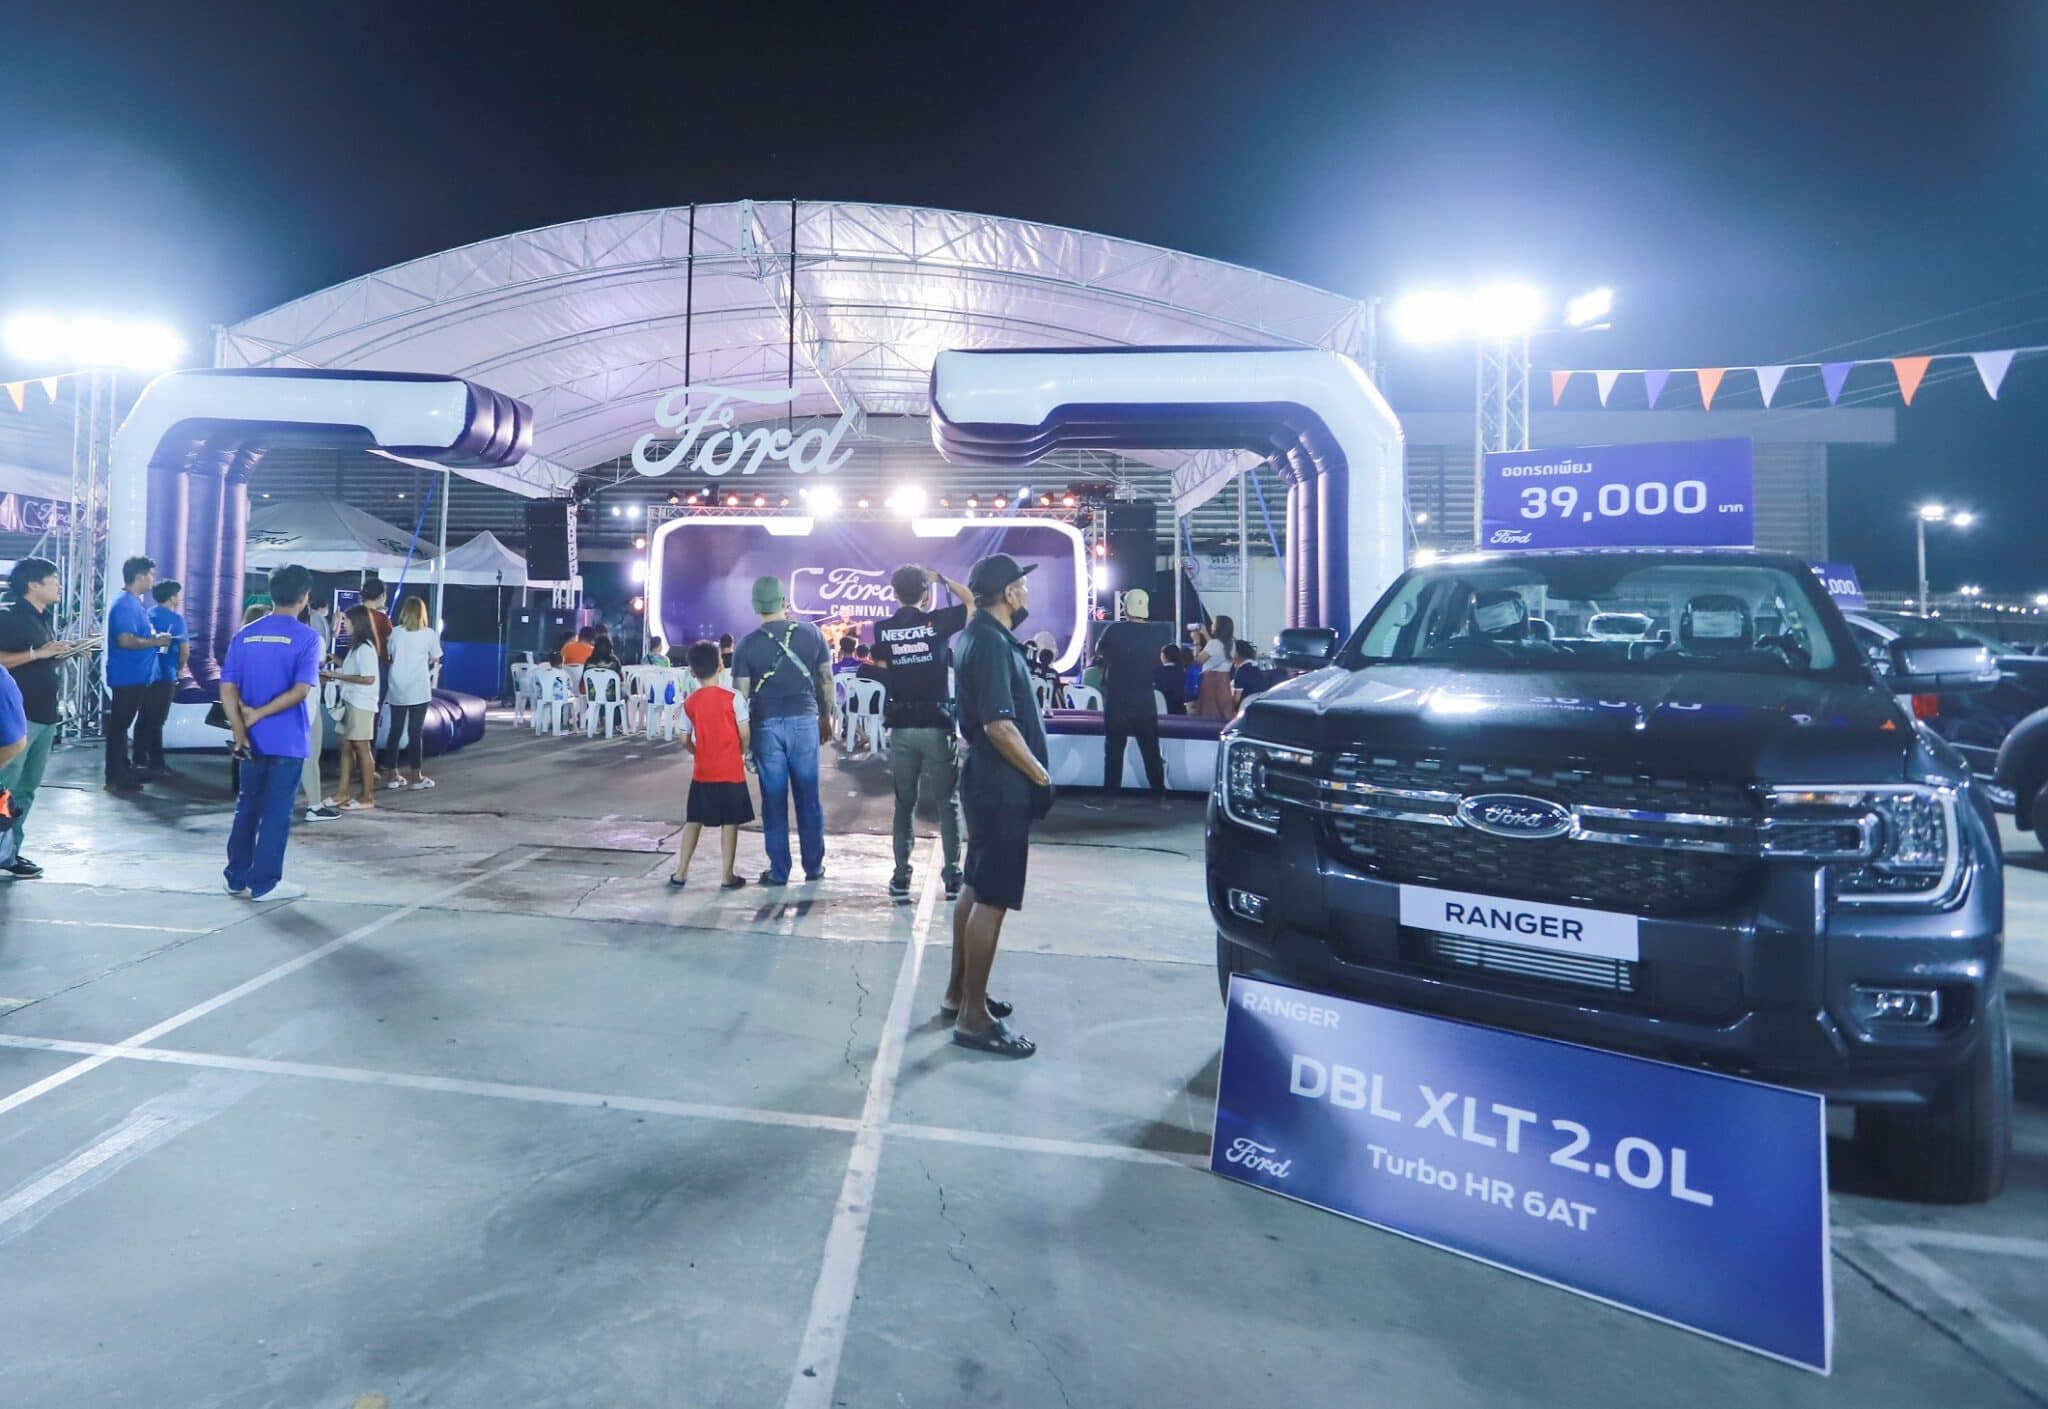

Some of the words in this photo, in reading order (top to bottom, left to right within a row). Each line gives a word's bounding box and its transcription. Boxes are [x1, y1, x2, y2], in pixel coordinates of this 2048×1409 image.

[631, 385, 860, 478] Ford
[1501, 459, 1593, 477] ออกรถเพียง
[1519, 479, 1708, 523] 39,000
[1717, 502, 1745, 513] บาท
[1489, 529, 1533, 545] Ford
[1485, 803, 1543, 828] Ford
[1444, 901, 1584, 942] RANGER
[1241, 991, 1341, 1031] RANGER
[1289, 1053, 1402, 1122] DBL
[1413, 1084, 1538, 1154] XLT
[1549, 1118, 1715, 1208] 2.0L
[1224, 1136, 1293, 1180] Ford
[1366, 1142, 1458, 1192] Turbo
[1463, 1171, 1515, 1210] HR
[1522, 1191, 1597, 1232] 6AT
